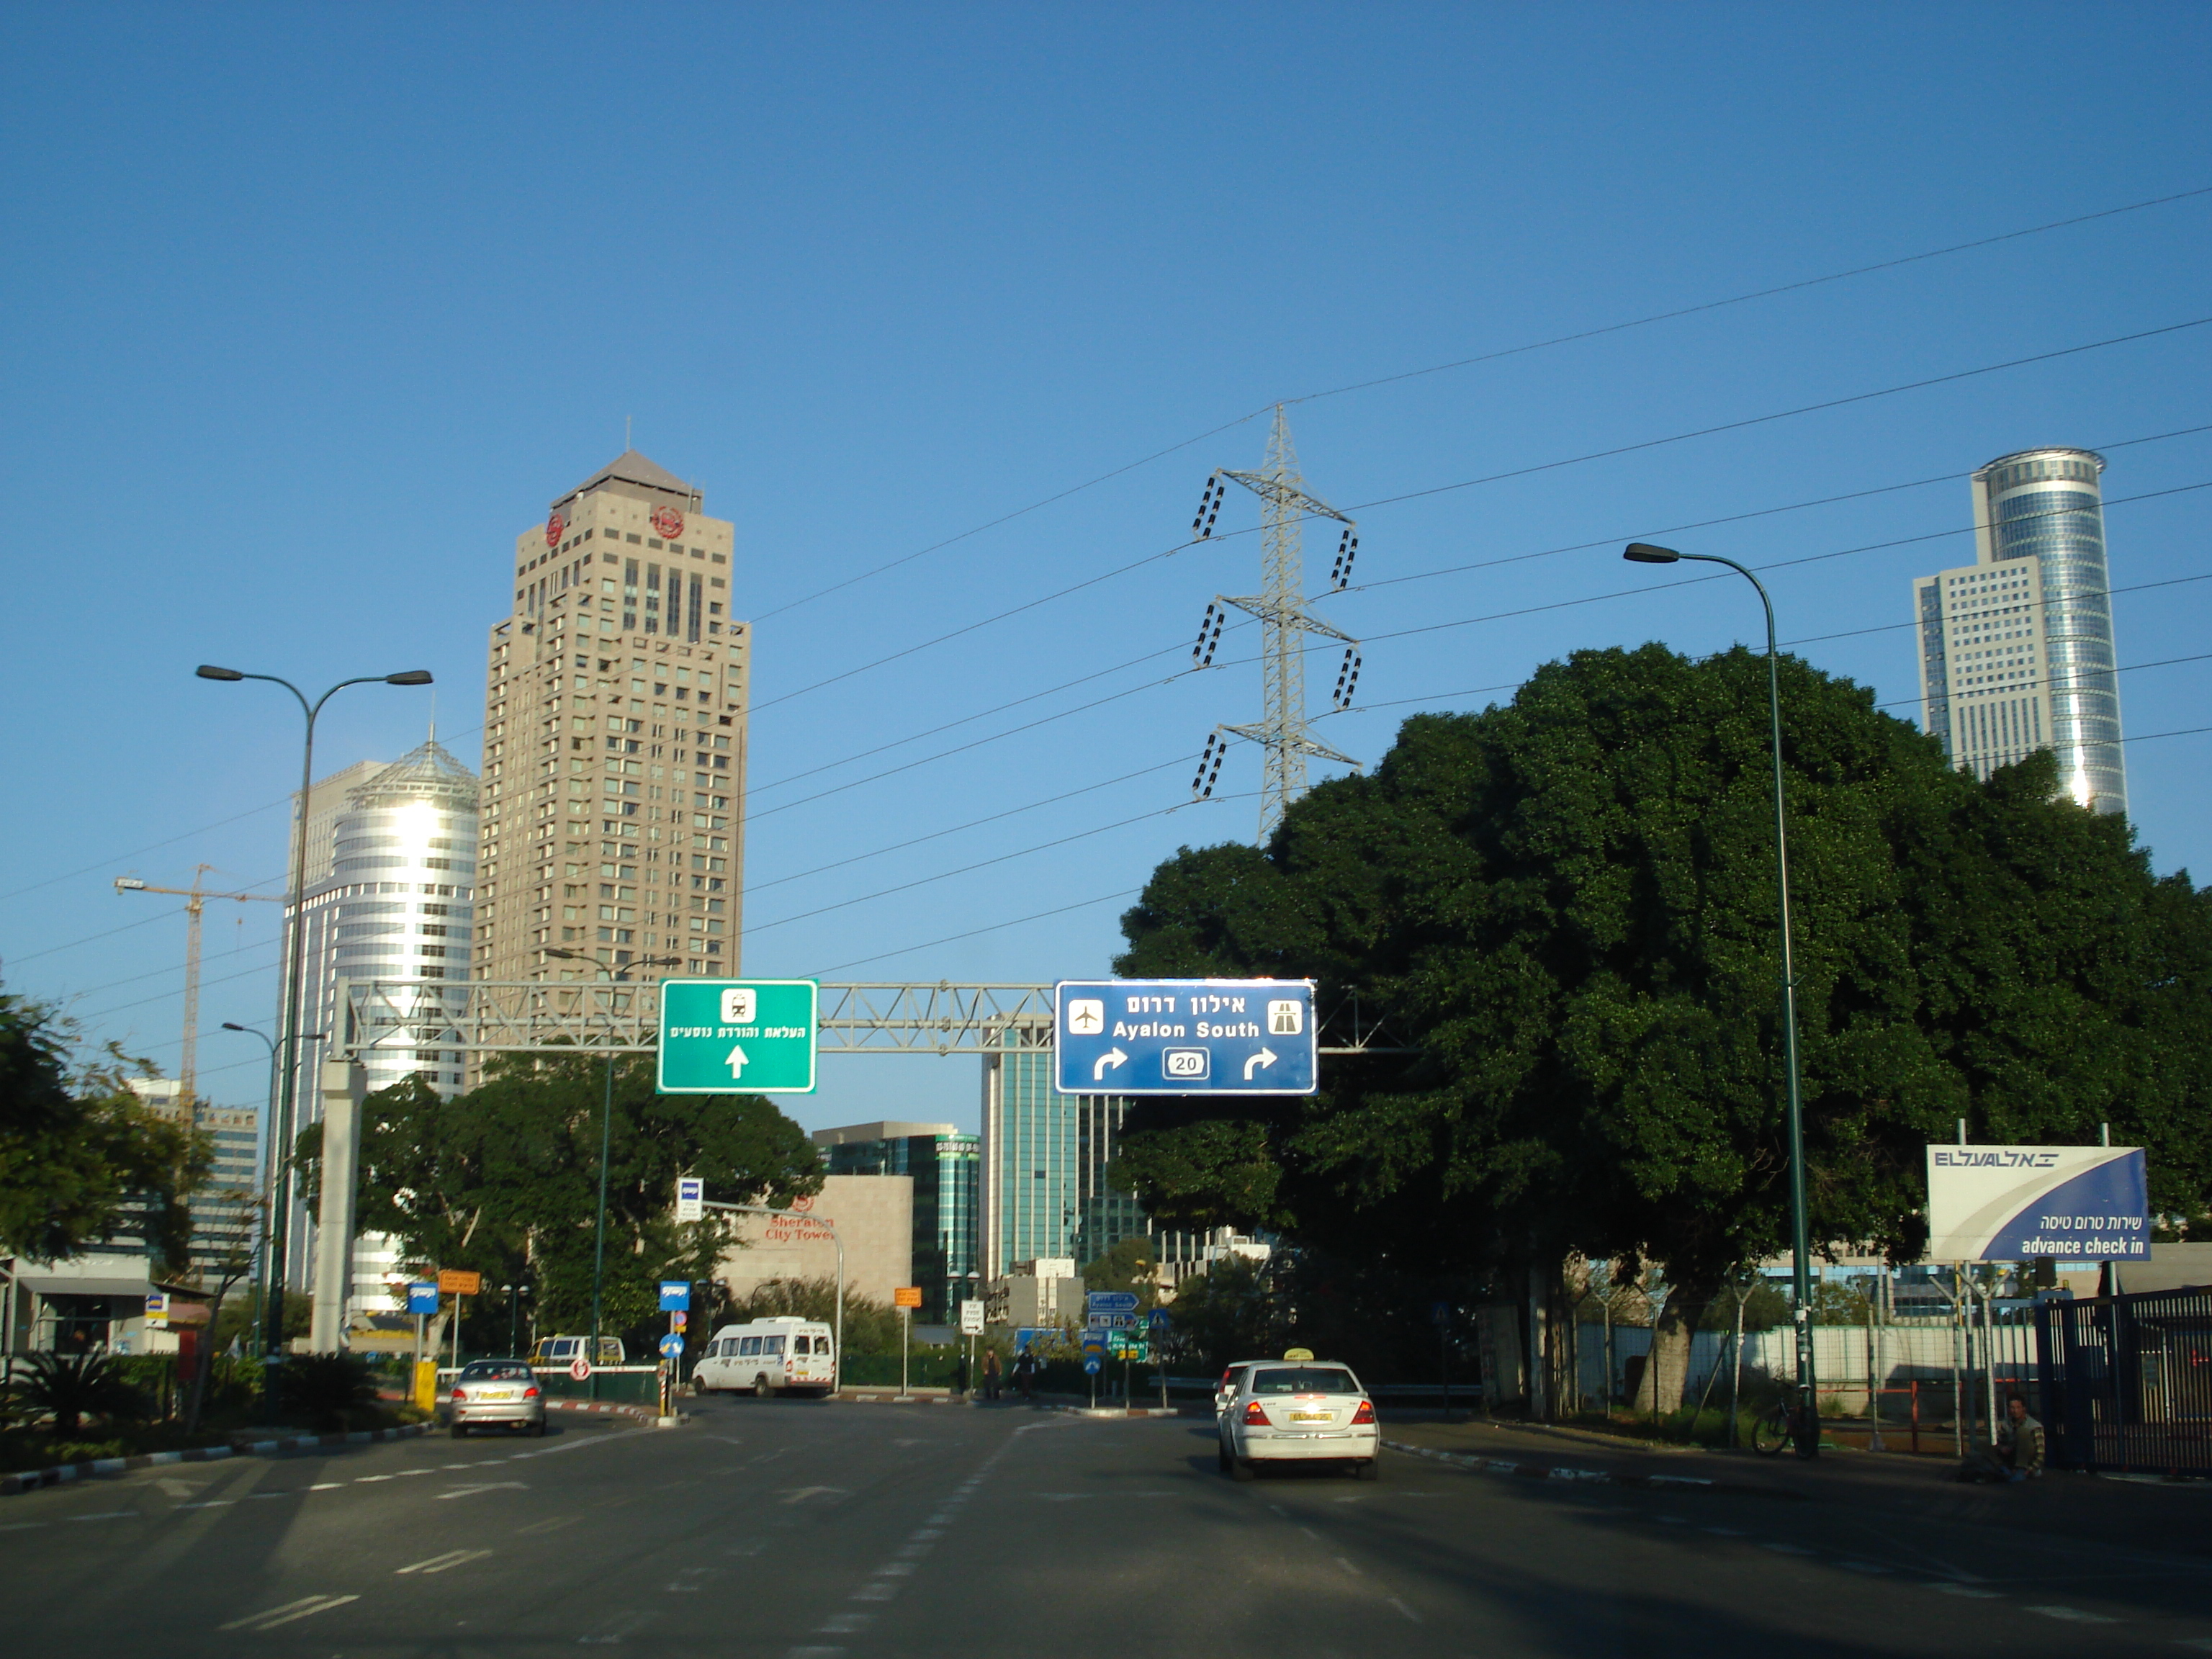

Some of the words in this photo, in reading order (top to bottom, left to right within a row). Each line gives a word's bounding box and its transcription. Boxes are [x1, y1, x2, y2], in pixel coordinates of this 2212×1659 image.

[1127, 997, 1175, 1013] דרום
[1191, 996, 1245, 1015] אילון
[670, 1026, 712, 1038] נוסעים
[717, 1026, 759, 1038] והורדת
[764, 1026, 806, 1038] העלאת
[1112, 1021, 1185, 1041] Ayalon
[1196, 1021, 1260, 1038] South
[1175, 1056, 1197, 1071] 20
[2040, 1215, 2072, 1230] טיסה
[2074, 1216, 2104, 1230] טרום
[2107, 1216, 2142, 1230] שירות
[765, 1228, 791, 1242] City
[2022, 1236, 2082, 1254] advance
[2085, 1236, 2126, 1254] check
[2130, 1236, 2144, 1254] in
